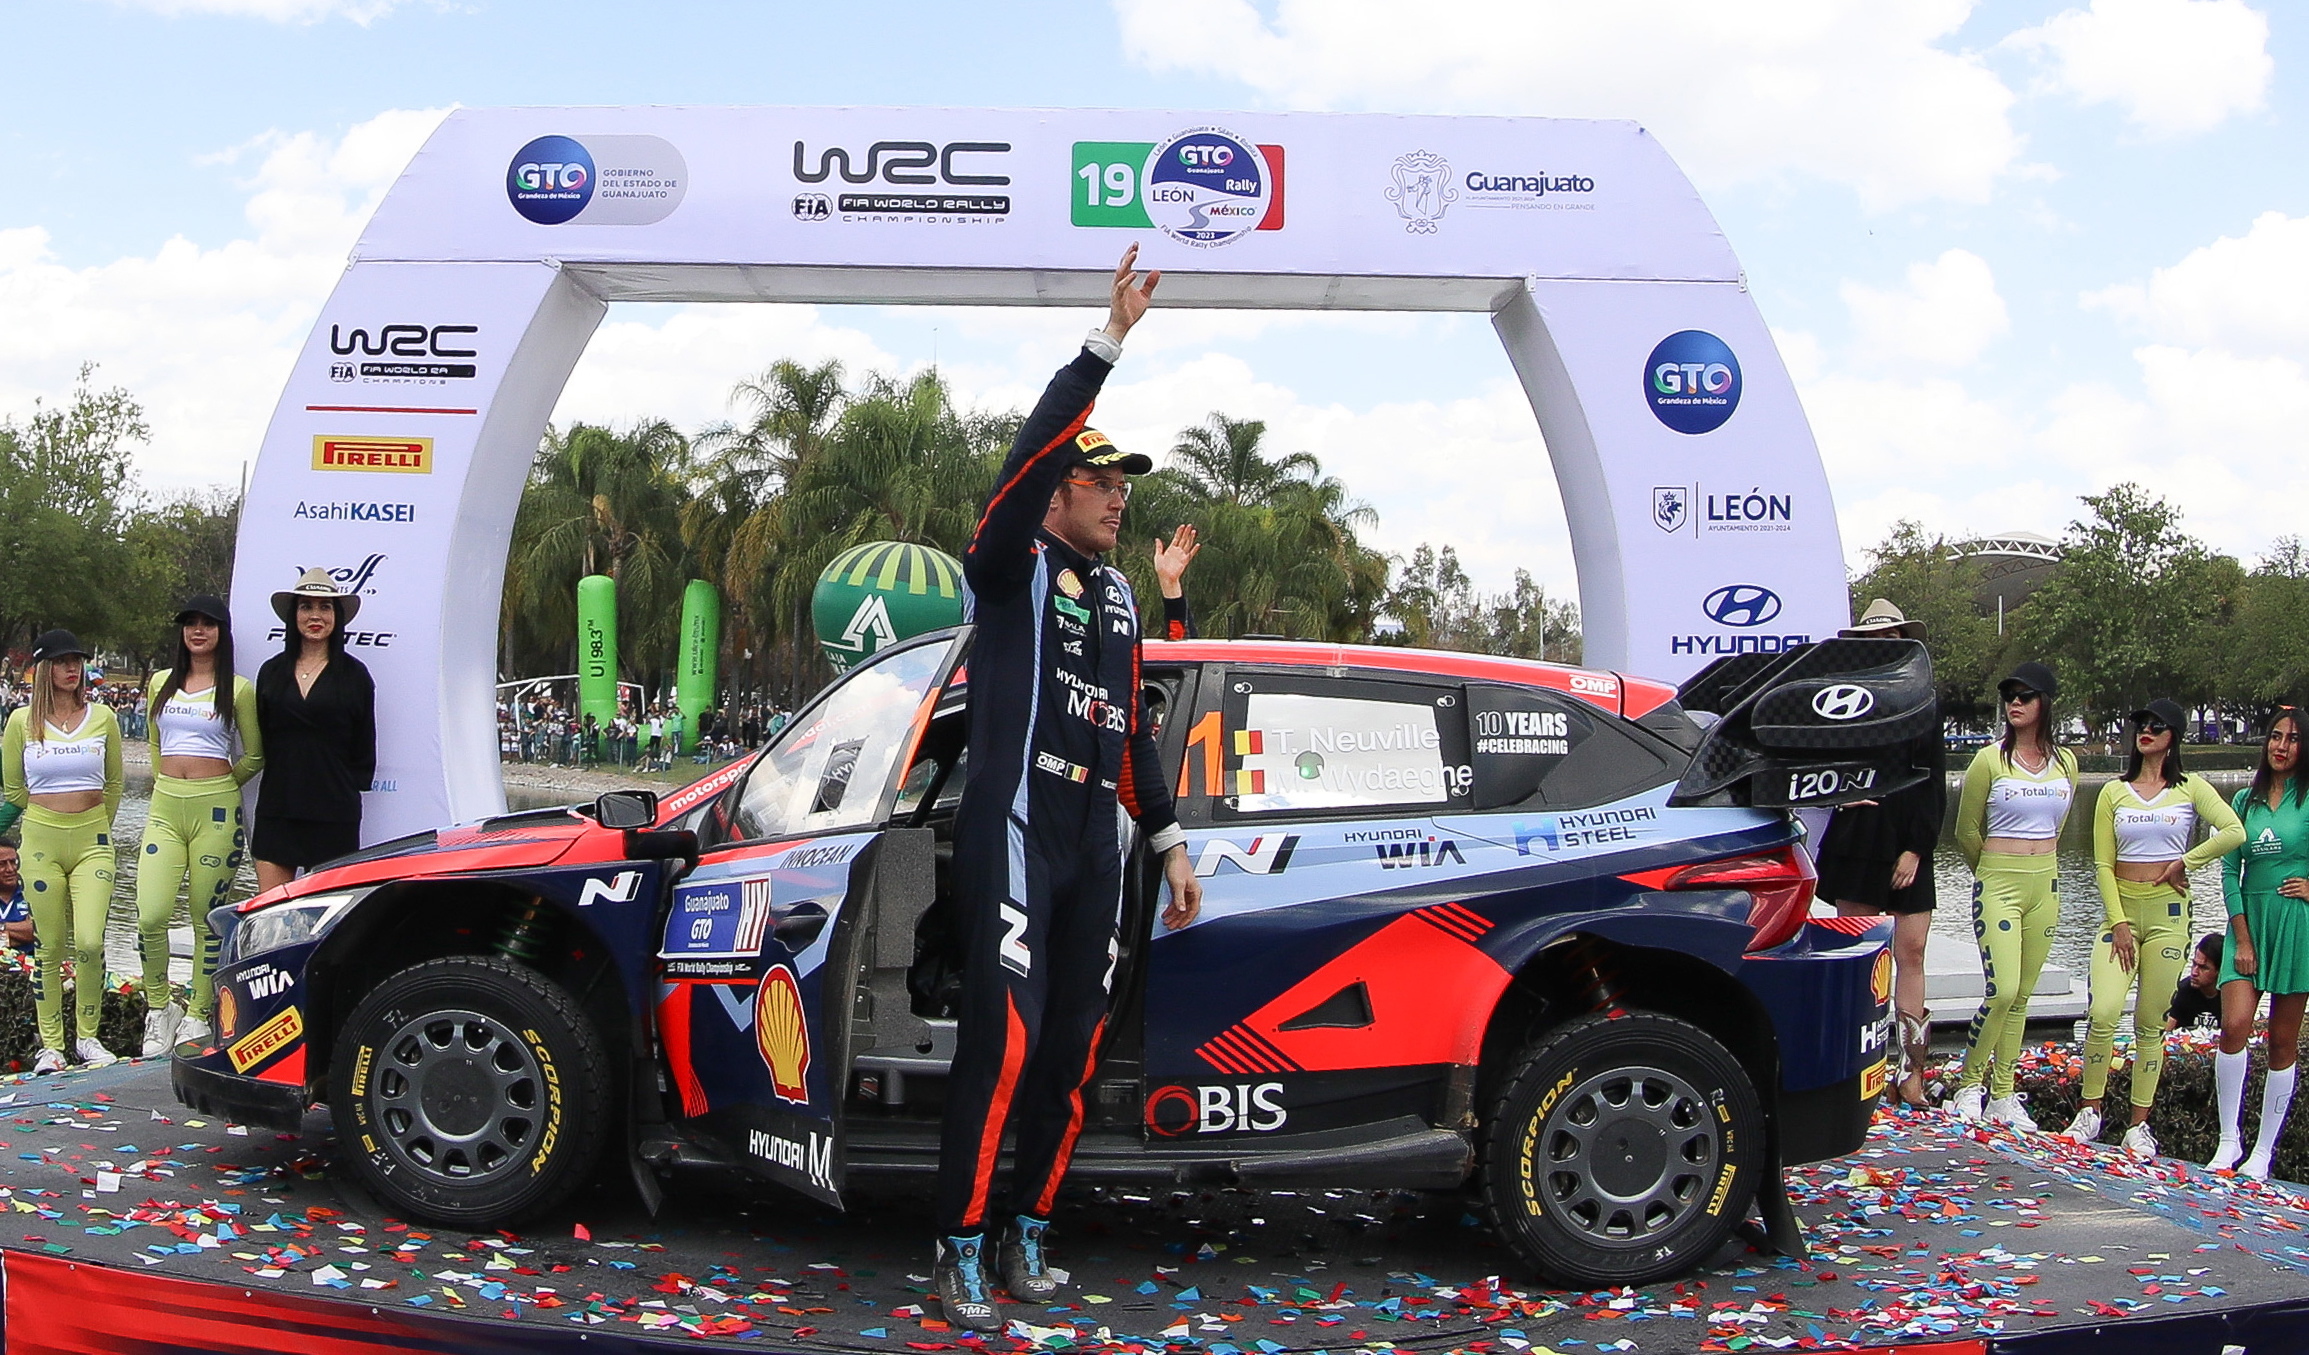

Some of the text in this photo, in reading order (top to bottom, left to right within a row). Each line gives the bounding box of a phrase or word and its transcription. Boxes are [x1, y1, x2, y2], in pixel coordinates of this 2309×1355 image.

[794, 140, 1011, 186] WRC
[1179, 145, 1233, 166] GTO
[516, 162, 587, 190] GTO
[602, 180, 677, 188] DEL ESTADO DE
[603, 169, 654, 177] GOBIERNO
[1466, 170, 1594, 197] Guanajuato
[518, 191, 549, 200] Grandeza
[549, 191, 558, 200] de
[602, 190, 667, 199] GUANAJUATO
[1078, 162, 1135, 207] 19
[1152, 186, 1194, 202] LEÓN
[1225, 179, 1257, 193] Rally
[843, 198, 1006, 210] FIA WORLD RALLY
[843, 215, 1005, 224] CHAMPIONSHIP
[1196, 231, 1216, 239] 2023
[331, 324, 478, 357] WRC
[384, 366, 428, 374] WORLD
[1654, 363, 1732, 394] GTO
[323, 441, 424, 468] PIRELLI
[1708, 487, 1790, 520] LEÓN
[591, 630, 603, 658] 98.3
[591, 666, 604, 677] U
[1570, 678, 1617, 694] OMP
[163, 706, 216, 720] Totalplay
[1476, 711, 1567, 736] 10 YEARS
[1271, 724, 1441, 754] T. Neuville
[1477, 738, 1569, 755] #CELEBRACING
[52, 745, 101, 756] Totalplay
[1177, 711, 1224, 797] 1
[1037, 755, 1065, 772] OMP
[380, 780, 397, 791] ALL
[1317, 761, 1473, 797] Wydaeghe
[1789, 770, 1838, 800] i20
[2021, 787, 2068, 800] Totalplay
[1559, 807, 1657, 829] HYUNDAI
[2127, 813, 2176, 825] Totalplay
[1344, 829, 1422, 842] HYUNDAI
[1564, 826, 1637, 847] STEEL
[779, 844, 854, 869] INNOCEAN
[685, 890, 729, 915] Guanajuato
[691, 918, 713, 940] GTO
[236, 963, 271, 982] HYUNDAI
[235, 1015, 298, 1065] PIRELLI
[352, 1045, 373, 1096] PIRELLI
[523, 1028, 561, 1173] SCORPION
[749, 1129, 804, 1171] HYUNDAI
[1521, 1071, 1574, 1217] SCORPION
[1706, 1163, 1736, 1216] PIRELLI
